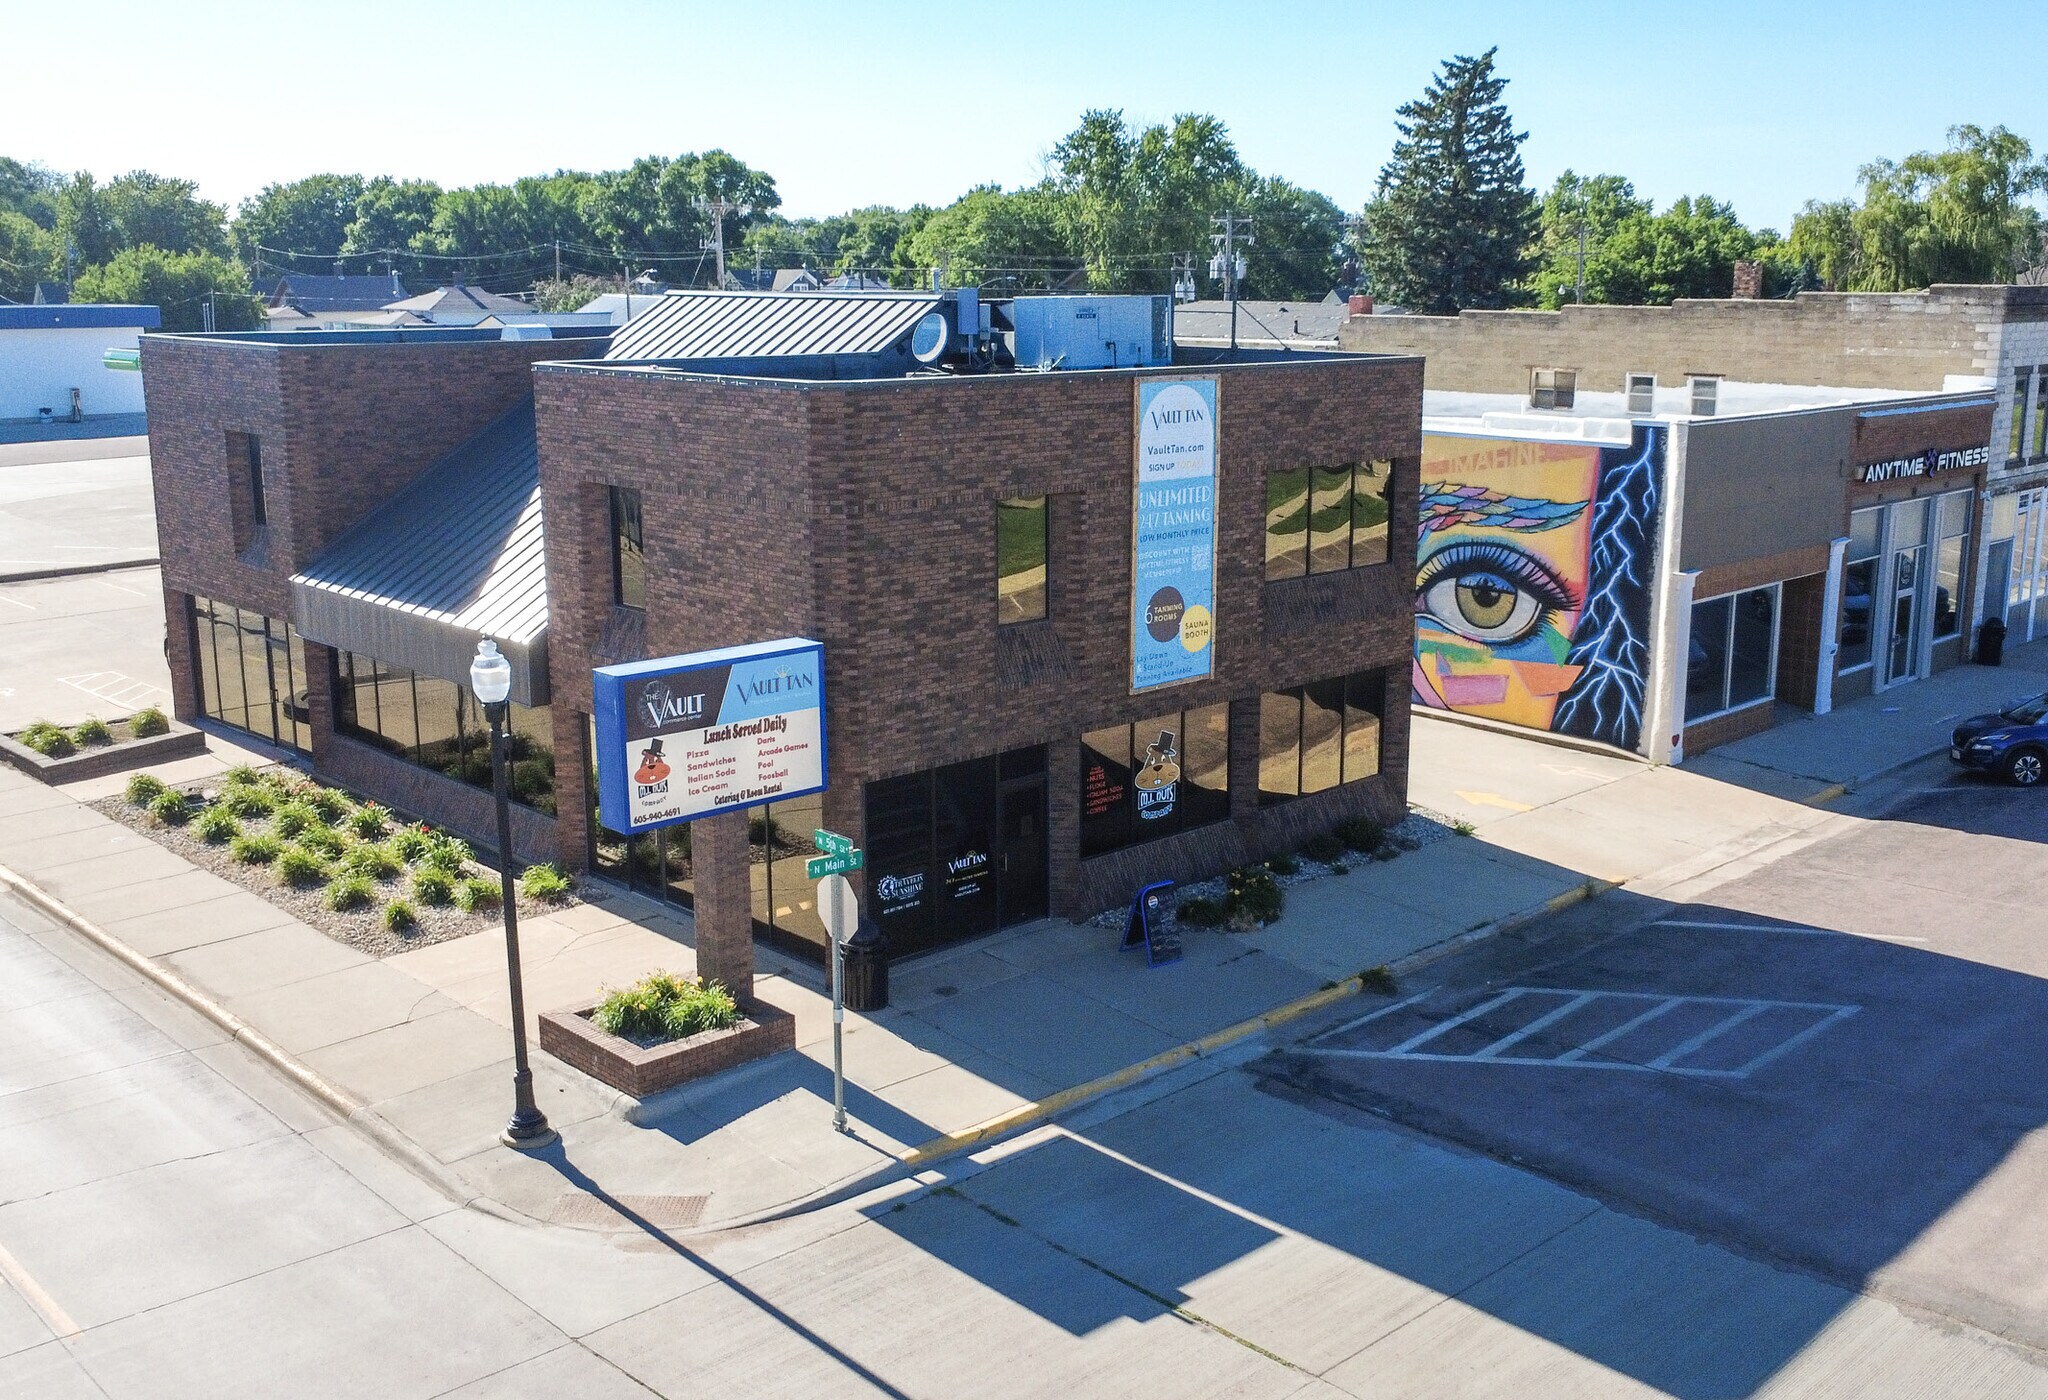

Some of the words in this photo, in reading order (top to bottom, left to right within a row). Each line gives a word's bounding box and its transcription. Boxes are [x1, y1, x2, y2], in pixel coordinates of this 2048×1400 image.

[1151, 405, 1182, 430] VAULT
[1185, 409, 1203, 423] TAN
[1148, 444, 1204, 455] VaultTan.com
[1148, 463, 1165, 472] SIGN
[1165, 462, 1175, 471] UP
[1865, 457, 1924, 483] ANYTIME
[1937, 446, 1989, 471] FITNESS
[1140, 485, 1211, 508] UNLIMITED
[1162, 507, 1211, 526] TANNING
[1156, 529, 1190, 540] MONTHLY
[1190, 527, 1209, 536] PRICE
[1145, 605, 1153, 624] 6
[1154, 603, 1183, 614] TANNING
[1154, 613, 1177, 622] ROOMS
[1185, 620, 1209, 630] SAUNA
[1185, 629, 1209, 639] BOOTH
[646, 692, 660, 701] THE
[736, 674, 780, 705] VAULT
[786, 673, 813, 691] TAN
[647, 690, 706, 728] VAULT
[703, 725, 732, 744] Lunch
[732, 719, 763, 739] Served
[764, 715, 787, 733] Daily
[757, 736, 775, 745] Darts
[686, 750, 709, 759] Pizza
[757, 747, 783, 757] Arcade
[784, 742, 808, 752] Games
[687, 757, 736, 771] Sandwiches
[758, 760, 774, 769] Pool
[688, 773, 714, 784] Italian
[715, 768, 736, 778] Soda
[758, 769, 789, 781] Foosball
[688, 788, 700, 796] Ice
[702, 783, 729, 792] Cream
[714, 792, 740, 805] Catering
[746, 788, 763, 799] Room
[763, 782, 783, 795] Rental
[633, 807, 681, 825] 605-940-4691
[826, 837, 837, 851] 5th
[839, 844, 846, 854] St
[814, 865, 820, 874] N
[825, 859, 845, 872] Main
[850, 857, 857, 866] St
[948, 857, 970, 874] VAULT
[972, 853, 987, 865] TAN
